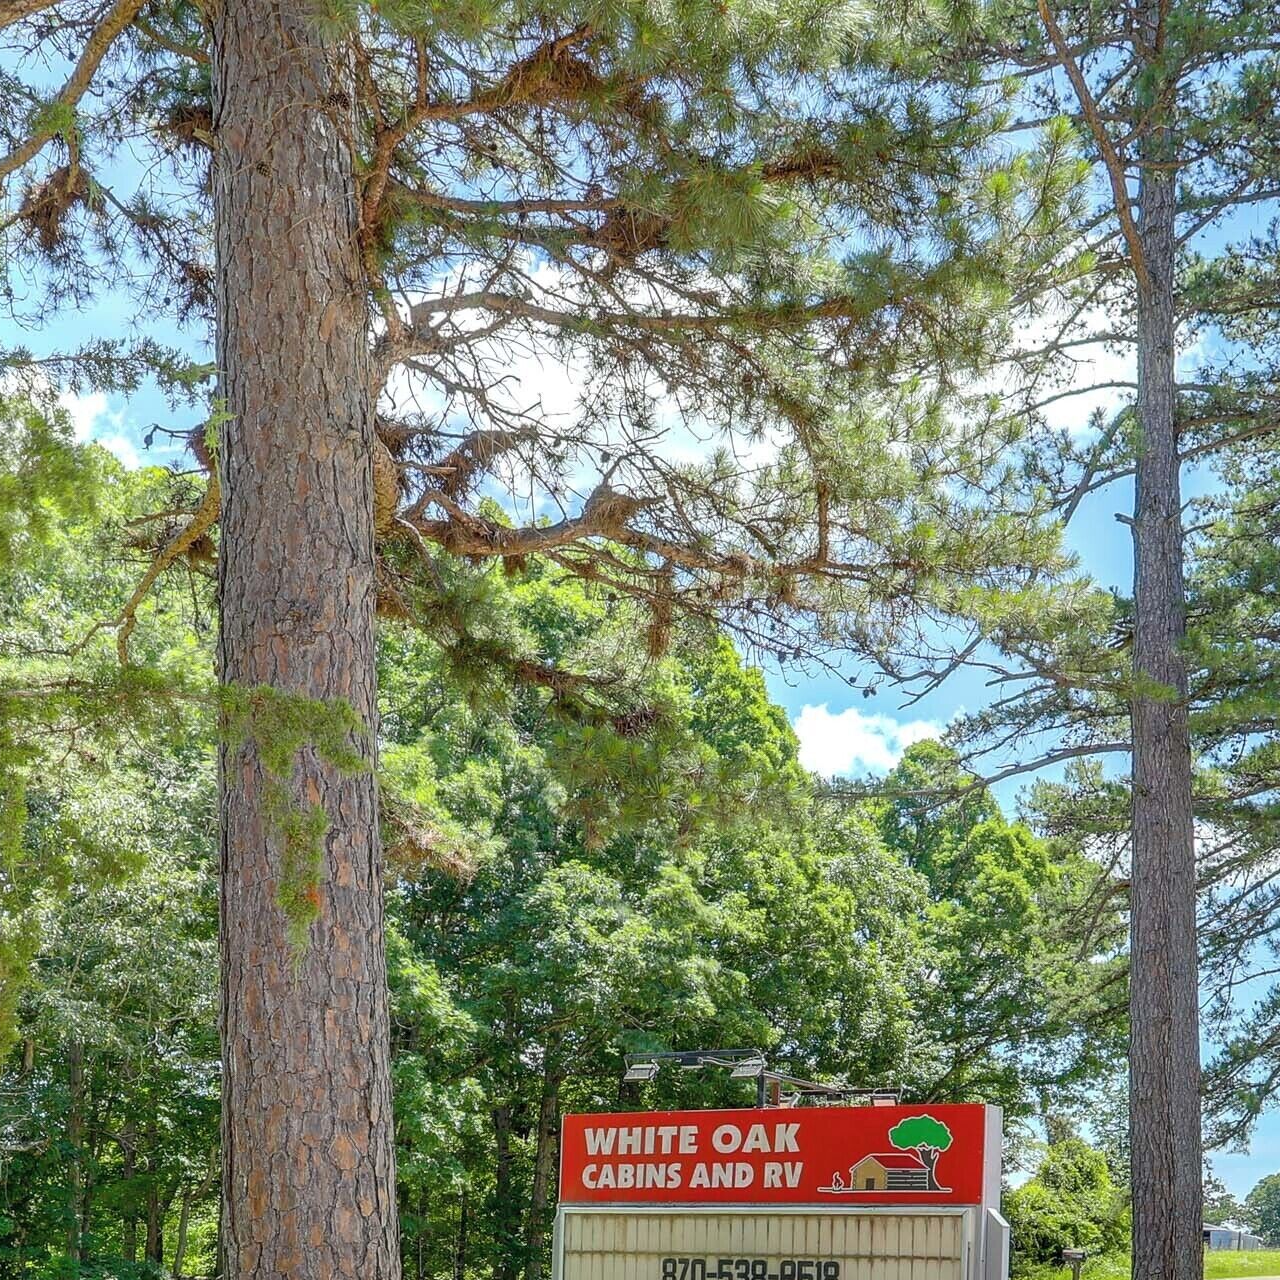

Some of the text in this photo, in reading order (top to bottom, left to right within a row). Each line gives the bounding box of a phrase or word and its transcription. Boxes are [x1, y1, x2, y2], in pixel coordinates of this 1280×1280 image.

[584, 1123, 801, 1156] WHITE OAK
[582, 1161, 803, 1190] CABINS AND RV
